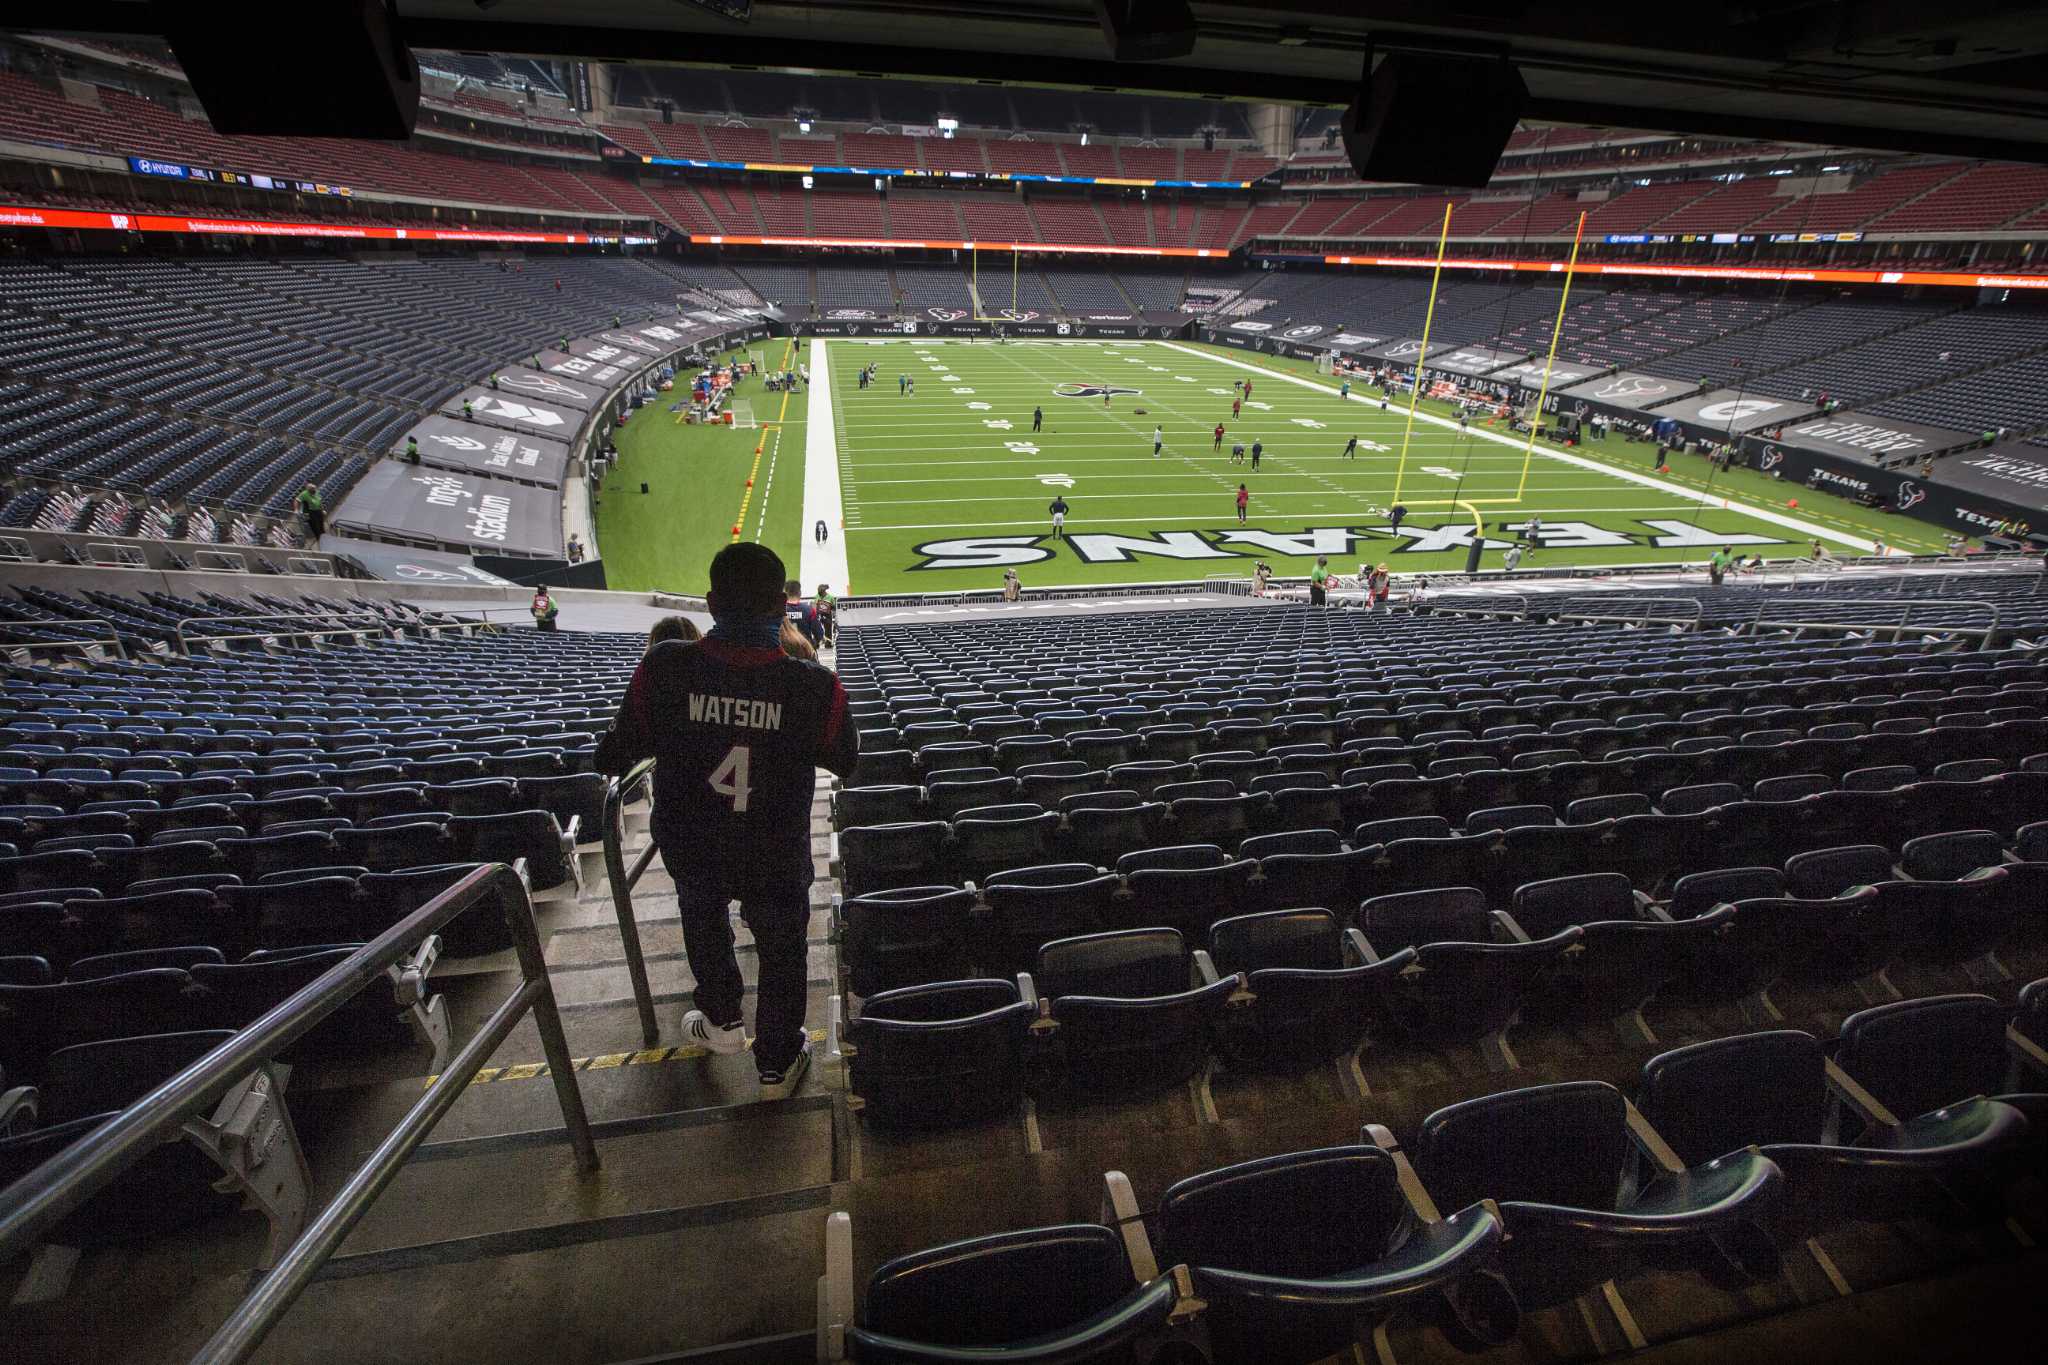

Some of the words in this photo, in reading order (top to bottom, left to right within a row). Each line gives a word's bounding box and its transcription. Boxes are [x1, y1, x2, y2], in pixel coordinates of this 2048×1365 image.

[426, 486, 473, 507] nrg
[1813, 468, 1870, 491] TEXANS
[465, 494, 512, 541] stadium
[906, 519, 1795, 571] TEXANS
[688, 692, 782, 731] WATSON
[708, 745, 753, 812] 4
